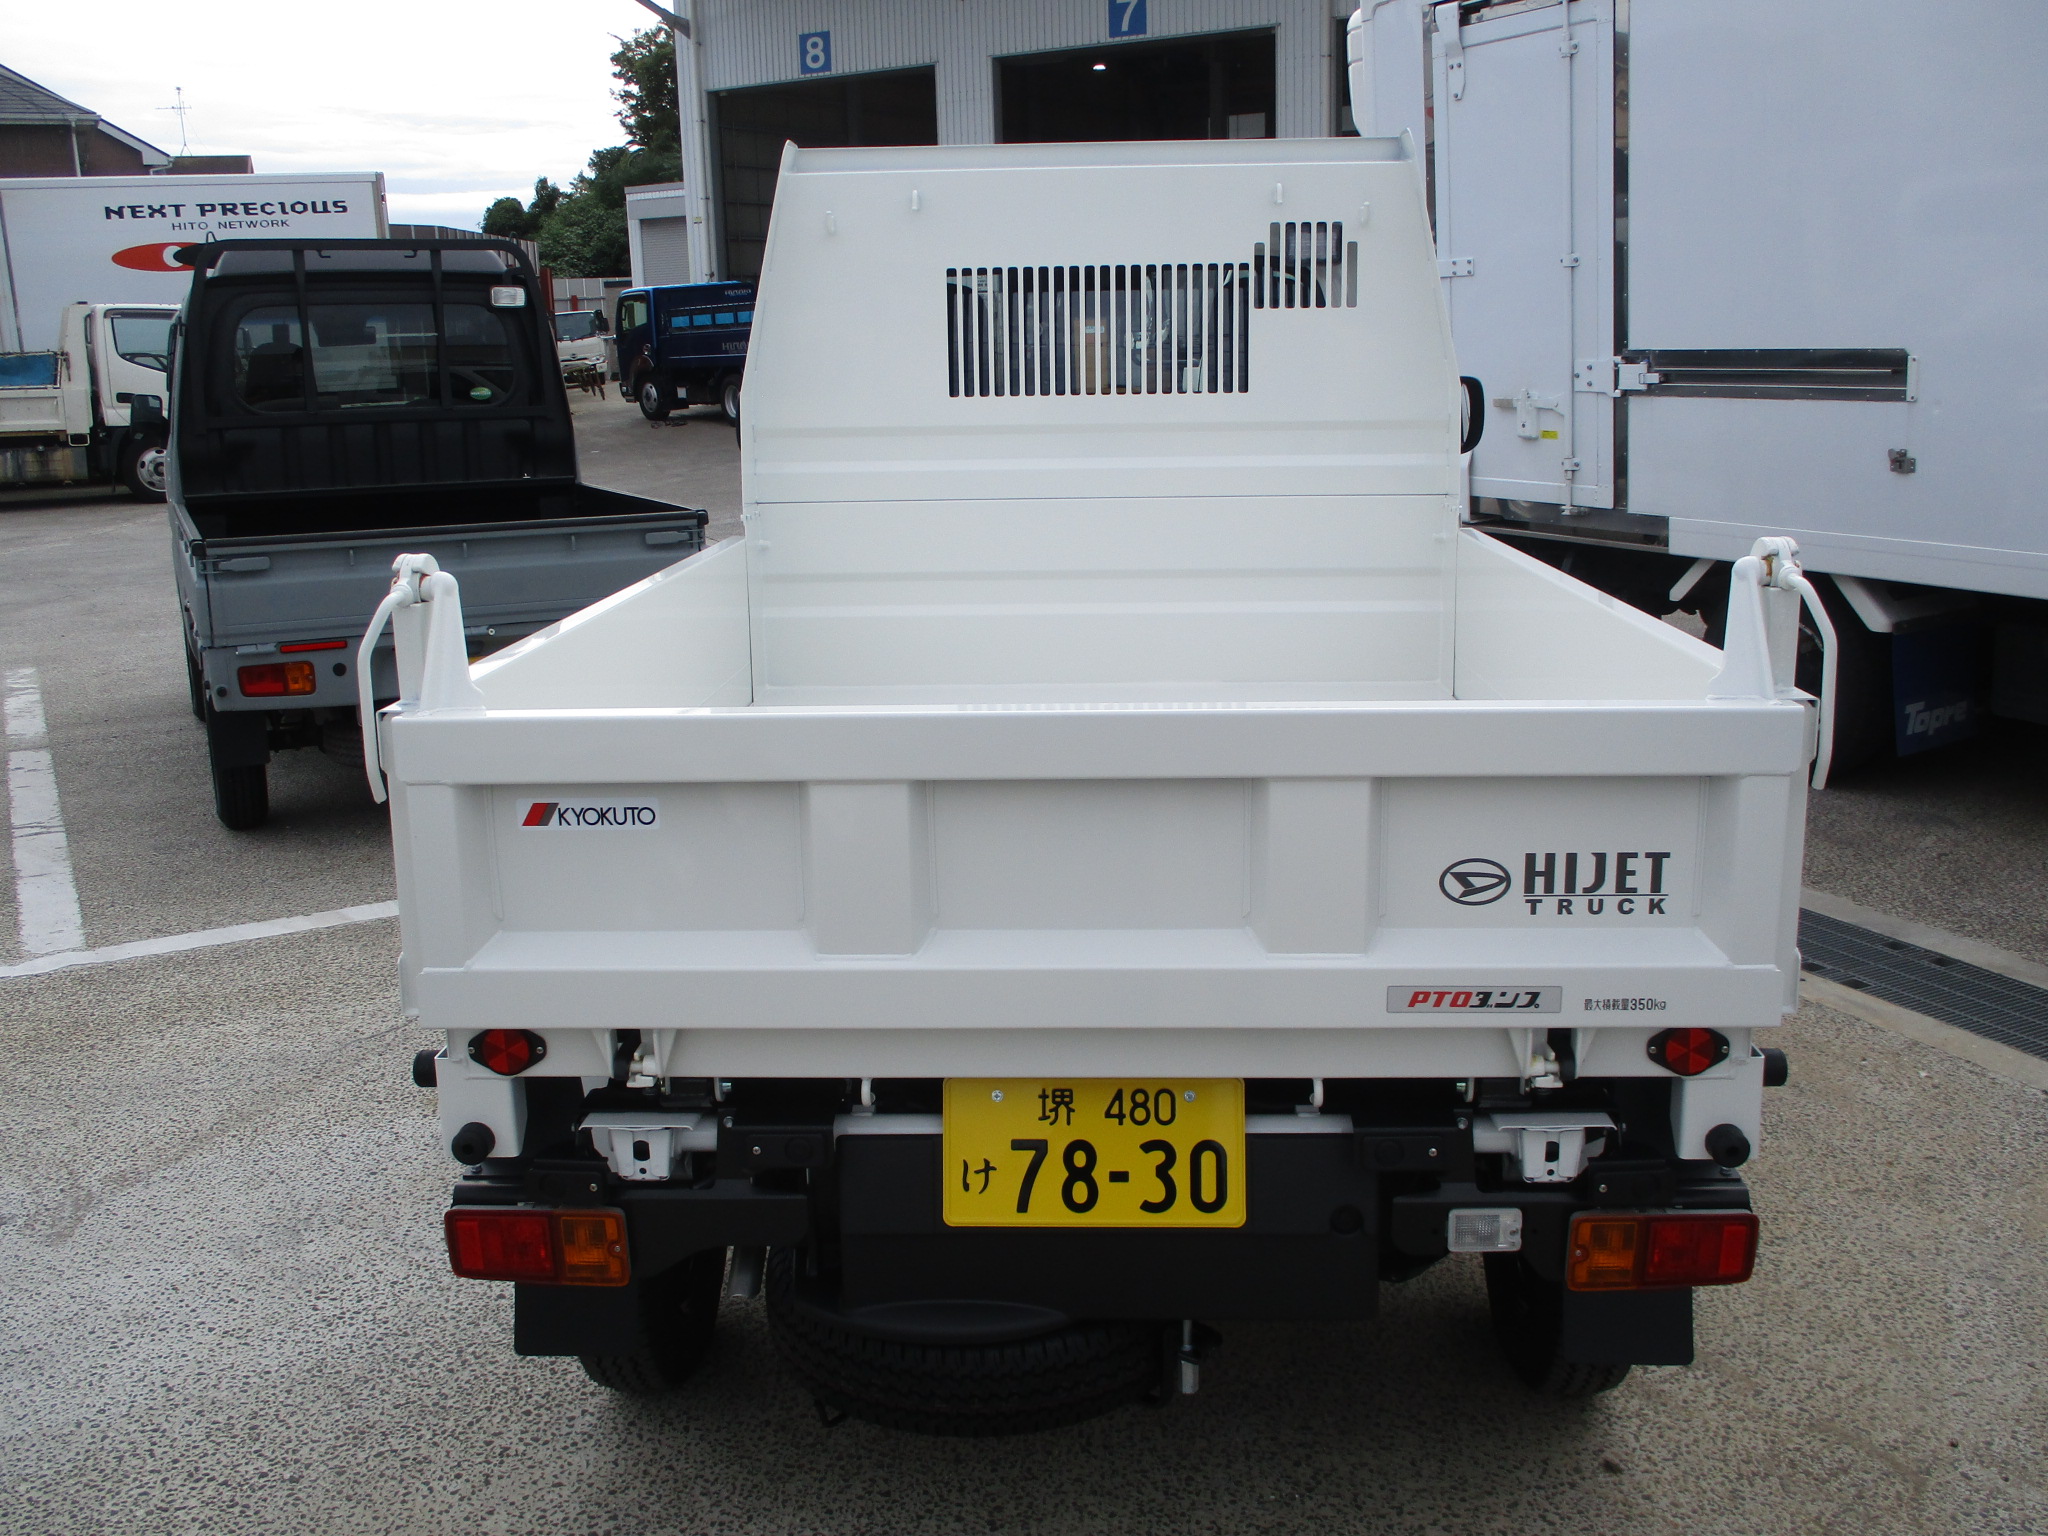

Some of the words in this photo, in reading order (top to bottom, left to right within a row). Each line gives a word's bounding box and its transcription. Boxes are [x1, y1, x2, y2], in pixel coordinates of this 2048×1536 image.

[1116, 0, 1139, 32] 7
[805, 36, 826, 69] 8
[104, 204, 186, 219] NEXT
[171, 221, 208, 231] HITO
[218, 219, 290, 230] NETWORK
[557, 806, 656, 826] KYOKUTO
[1523, 852, 1671, 894] HIJET
[1525, 898, 1666, 915] TRUCK
[1038, 1088, 1075, 1126] 堺
[1104, 1088, 1176, 1126] 480
[962, 1158, 997, 1195] け
[1010, 1139, 1228, 1214] 78-30
